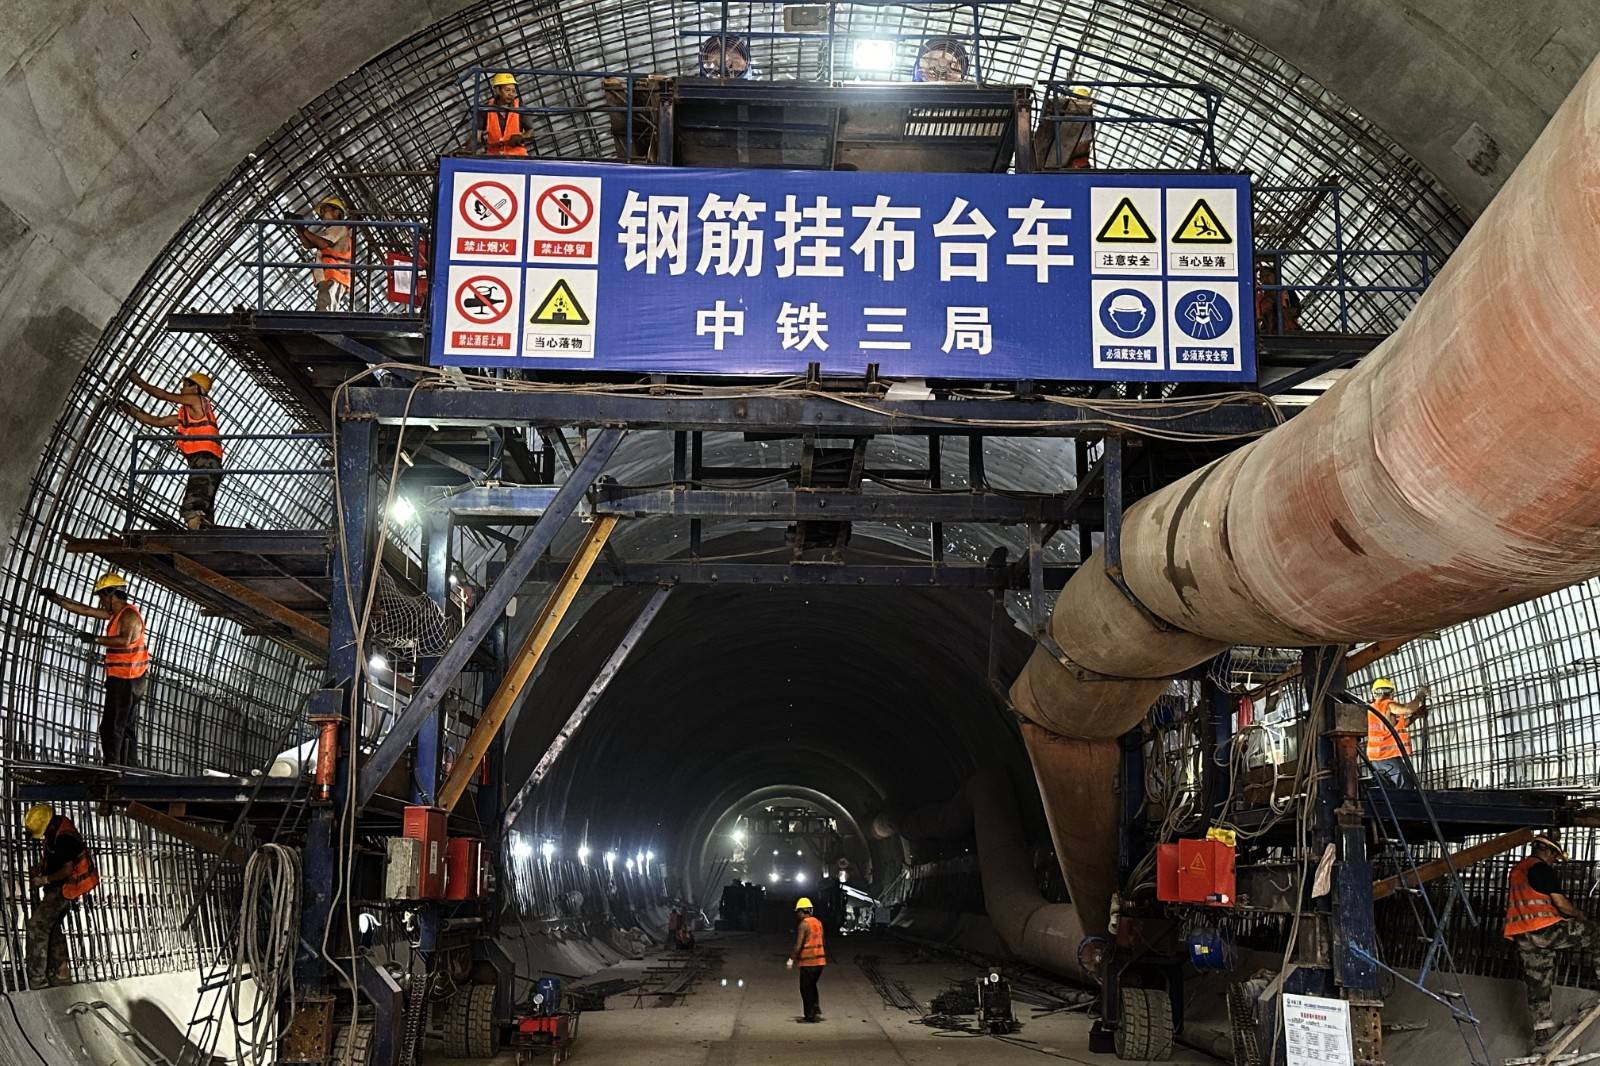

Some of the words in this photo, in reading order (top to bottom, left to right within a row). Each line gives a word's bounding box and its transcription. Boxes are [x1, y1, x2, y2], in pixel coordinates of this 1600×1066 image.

[617, 189, 1075, 284] 钢筋挂布台车
[463, 239, 511, 254] 禁止烟火
[540, 242, 587, 256] 禁止停留
[1102, 254, 1151, 267] 注意安全
[1178, 255, 1227, 268] 当心坠落
[695, 299, 993, 356] 中铁三局
[534, 336, 584, 349] 当心落物
[1181, 349, 1229, 362] 必须系安全带
